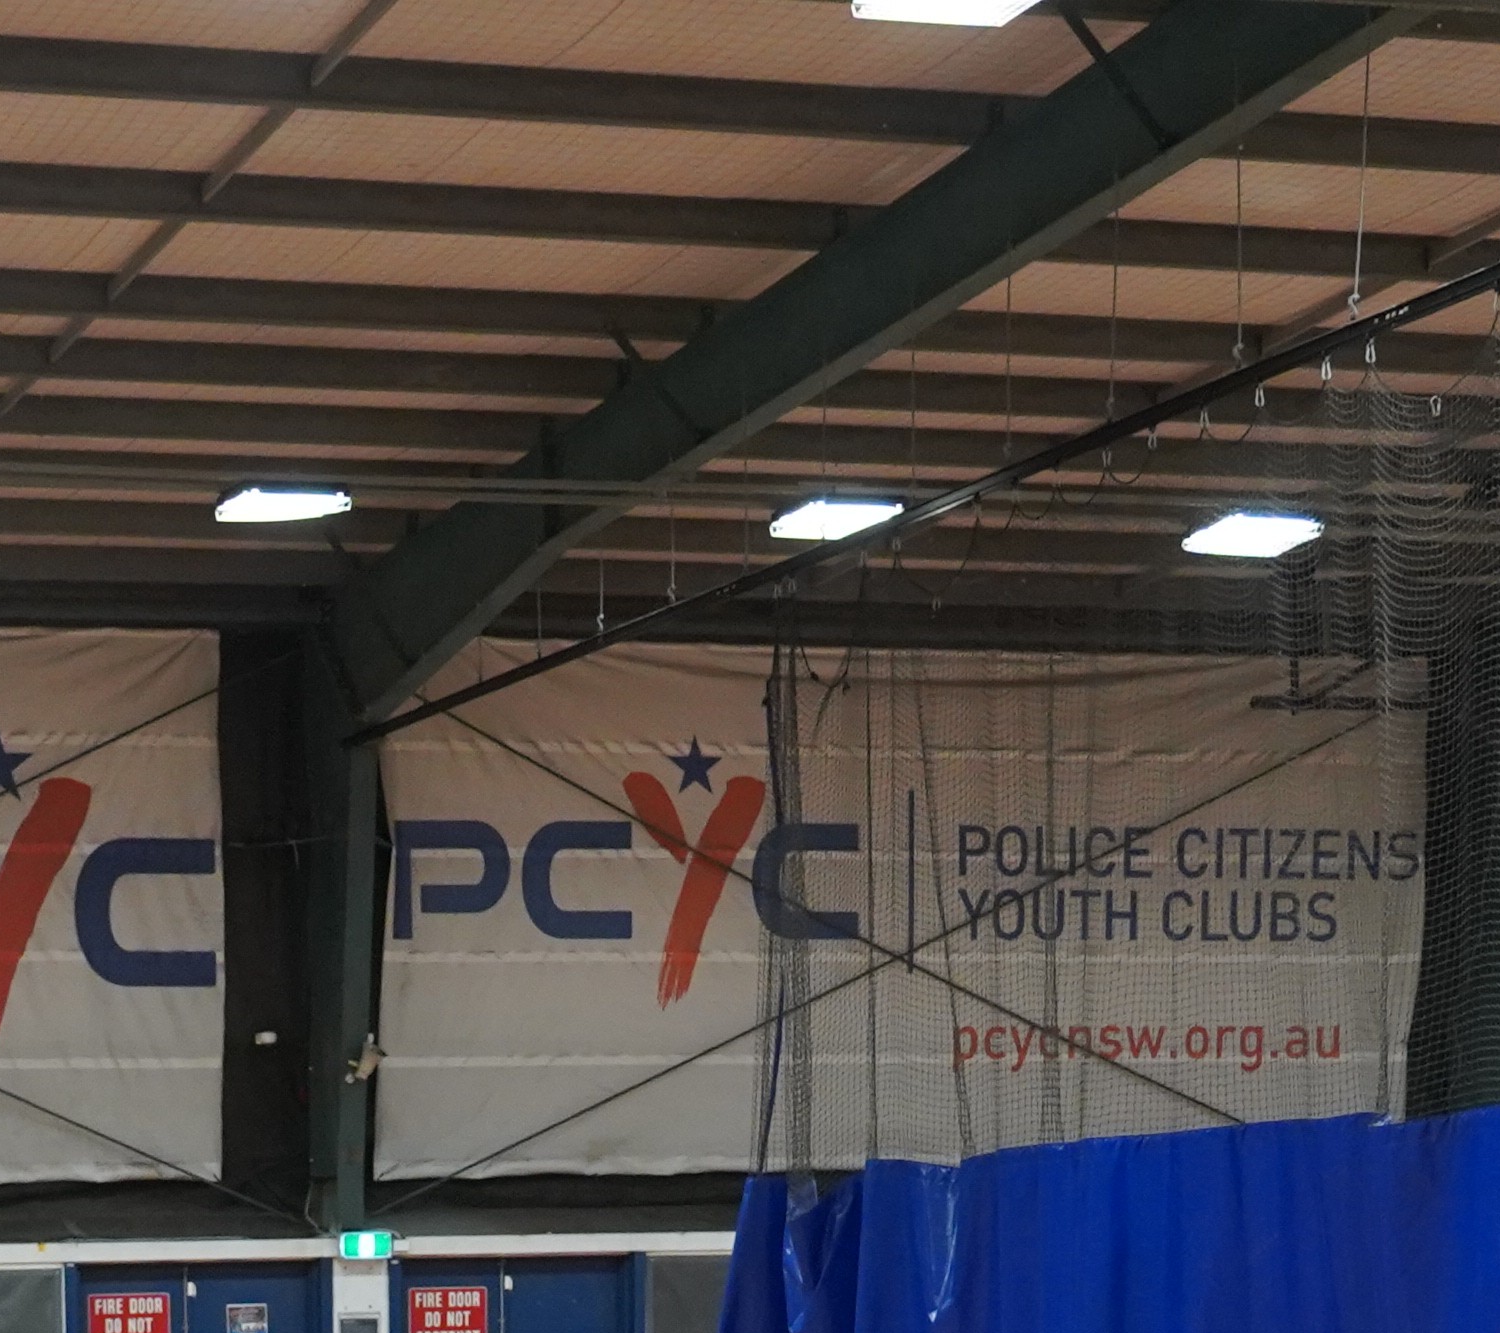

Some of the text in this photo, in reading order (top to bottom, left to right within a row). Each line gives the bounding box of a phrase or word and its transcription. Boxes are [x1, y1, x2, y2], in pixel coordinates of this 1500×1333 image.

[957, 825, 1421, 881] POLICE CITIZENS
[393, 771, 860, 1010] PCYC
[958, 889, 1338, 942] YOUTH CLUBS
[952, 1024, 1342, 1072] pcycnsw.org.au
[94, 1297, 163, 1315] FIRE DOOR
[415, 1291, 480, 1308] FIRE DOOR
[104, 1317, 153, 1333] DO NOT
[424, 1310, 471, 1327] DO NOT
